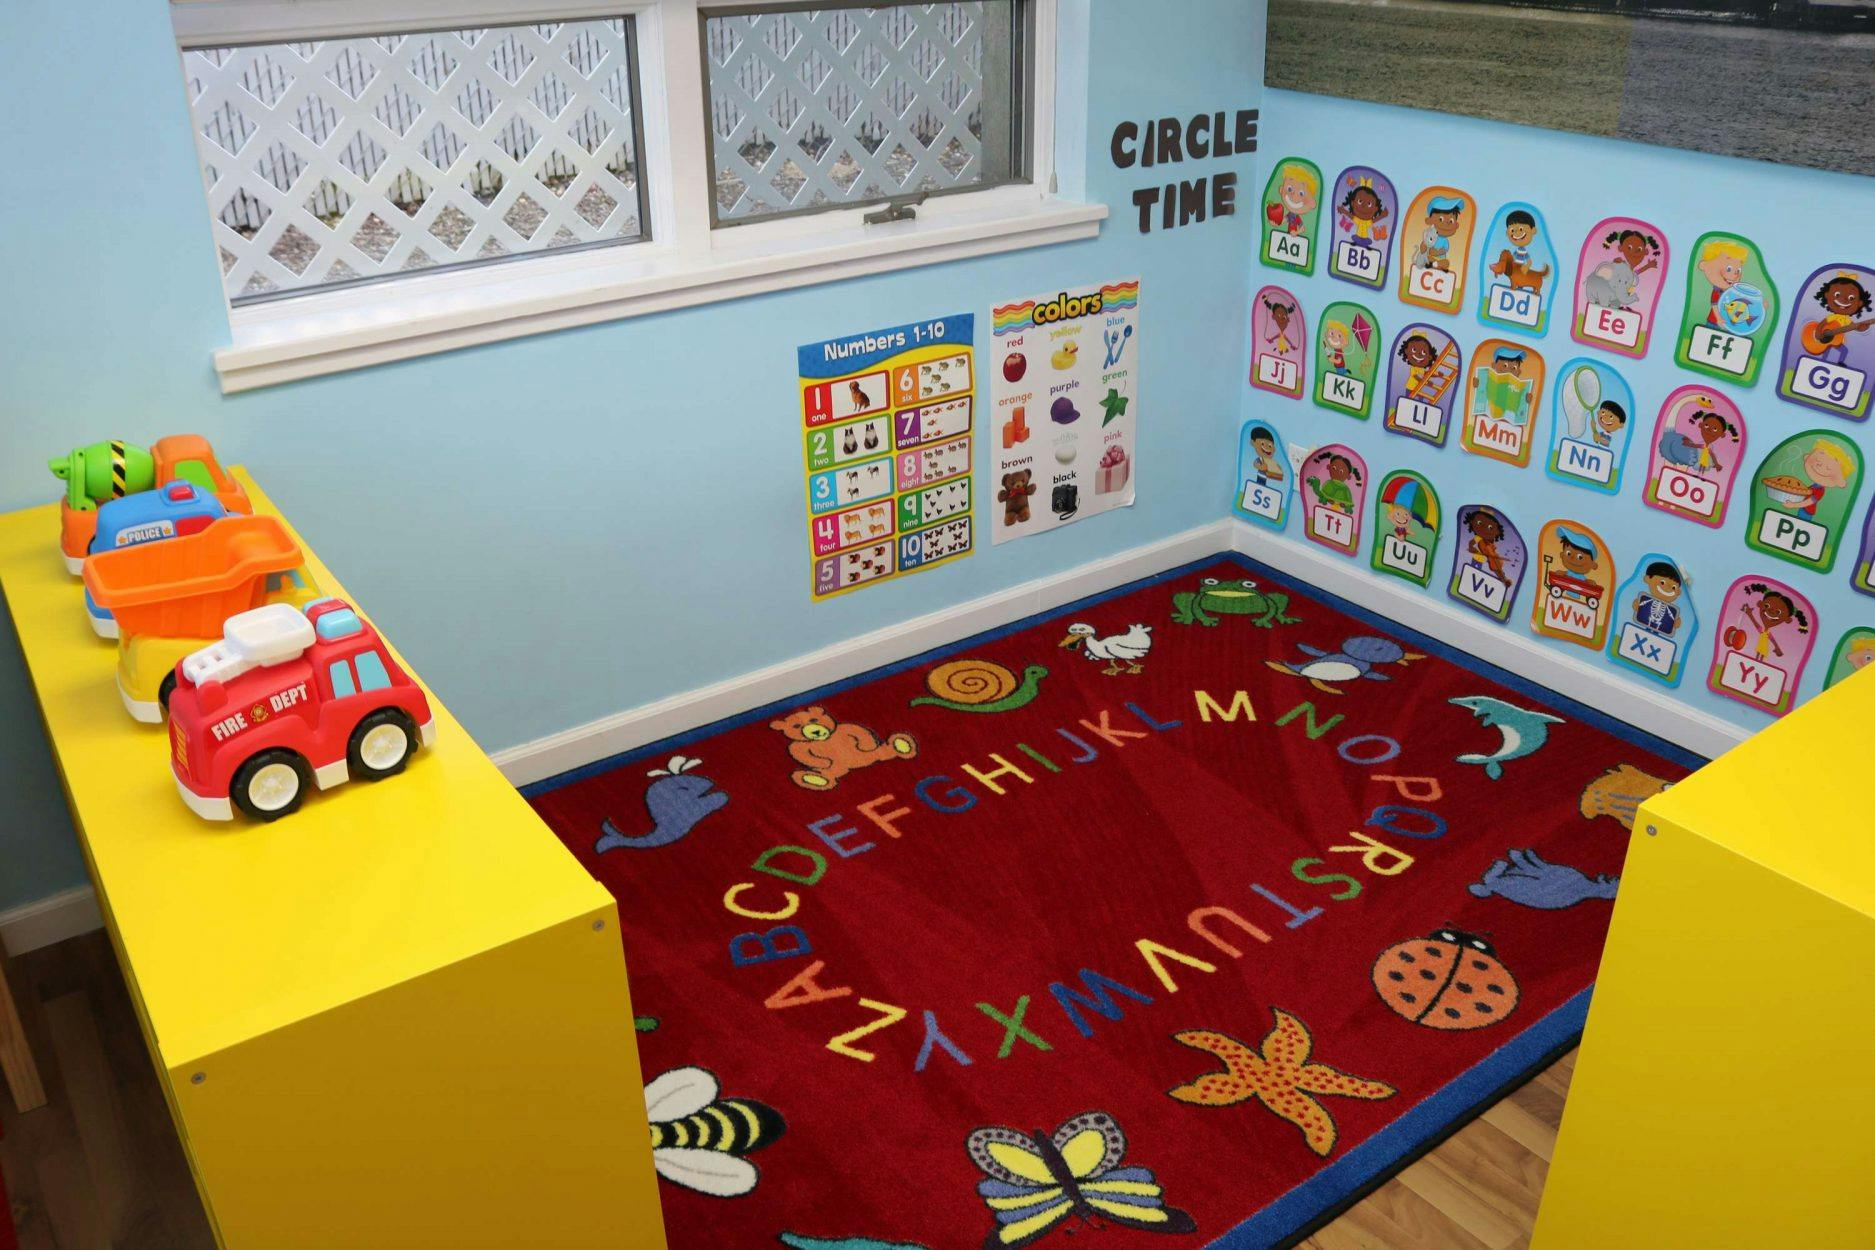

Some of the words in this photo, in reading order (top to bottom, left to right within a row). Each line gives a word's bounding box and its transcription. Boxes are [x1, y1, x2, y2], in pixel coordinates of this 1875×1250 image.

[1111, 108, 1259, 169] CIRCLE
[1132, 171, 1238, 234] TIME
[1277, 236, 1300, 258] Aa
[1347, 249, 1371, 271] Bb
[1420, 272, 1445, 294] Cc
[1032, 292, 1103, 326] colors
[1501, 291, 1531, 316] Dd
[1050, 325, 1082, 341] yellow
[1106, 315, 1125, 327] blue
[1598, 309, 1626, 335] Ee
[824, 332, 905, 361] Numbers
[913, 322, 945, 343] 1-10
[1007, 336, 1024, 349] red
[1706, 334, 1733, 360] Ff
[900, 369, 914, 391] 6
[1102, 369, 1128, 384] green
[1270, 360, 1286, 385] Jj
[1808, 366, 1850, 402] Gg
[815, 387, 821, 411] 1
[902, 393, 913, 403] six
[999, 392, 1033, 407] orange
[1050, 380, 1080, 396] purple
[1333, 377, 1356, 400] Kk
[811, 413, 827, 423] one
[901, 412, 915, 436] 7
[1412, 404, 1427, 426] Ll
[813, 432, 828, 455] 2
[897, 436, 920, 448] seven
[1103, 430, 1123, 444] pink
[1478, 420, 1517, 448] Mm
[814, 457, 829, 467] two
[903, 455, 916, 477] 8
[1001, 455, 1033, 470] brown
[1568, 445, 1601, 472] Nn
[815, 476, 830, 499] 3
[901, 478, 920, 489] eight
[1053, 470, 1077, 484] black
[1669, 475, 1705, 504] Oo
[814, 501, 835, 511] three
[903, 495, 917, 516] 9
[1252, 488, 1272, 509] Ss
[127, 526, 162, 544] POLICE
[818, 518, 834, 540] 4
[903, 518, 919, 528] nine
[1324, 514, 1342, 534] Tt
[1775, 518, 1811, 551] Pp
[819, 542, 836, 552] four
[902, 535, 921, 559] 10
[1392, 541, 1418, 565] Uu
[821, 560, 834, 582] 5
[904, 559, 917, 568] ten
[819, 583, 834, 593] five
[1471, 573, 1494, 599] Vv
[1551, 601, 1591, 629] Ww
[1630, 633, 1661, 662] Xx
[1739, 661, 1769, 695] Yy
[211, 711, 248, 742] FIRE
[269, 683, 309, 713] DEPT
[1124, 701, 1184, 732] L
[1194, 689, 1258, 723] M
[1078, 710, 1149, 747] K
[1274, 701, 1346, 740] N
[1016, 742, 1062, 773] I
[1056, 727, 1098, 763] J
[1337, 734, 1401, 765] O
[960, 752, 1035, 795] H
[914, 775, 979, 814] G
[1370, 774, 1443, 802] P
[856, 793, 911, 838] F
[1364, 804, 1448, 840] Q
[807, 813, 877, 858] E
[751, 844, 828, 886] D
[1328, 831, 1415, 876] R
[1291, 857, 1364, 901] S
[723, 881, 800, 920] C
[1249, 882, 1325, 929] T
[728, 924, 813, 966] B
[1187, 905, 1273, 959] U
[1135, 938, 1217, 994] V
[764, 960, 853, 1009] A
[1047, 967, 1155, 1038] W
[825, 997, 908, 1063] Z
[975, 995, 1054, 1059] X
[914, 1009, 973, 1072] Y
